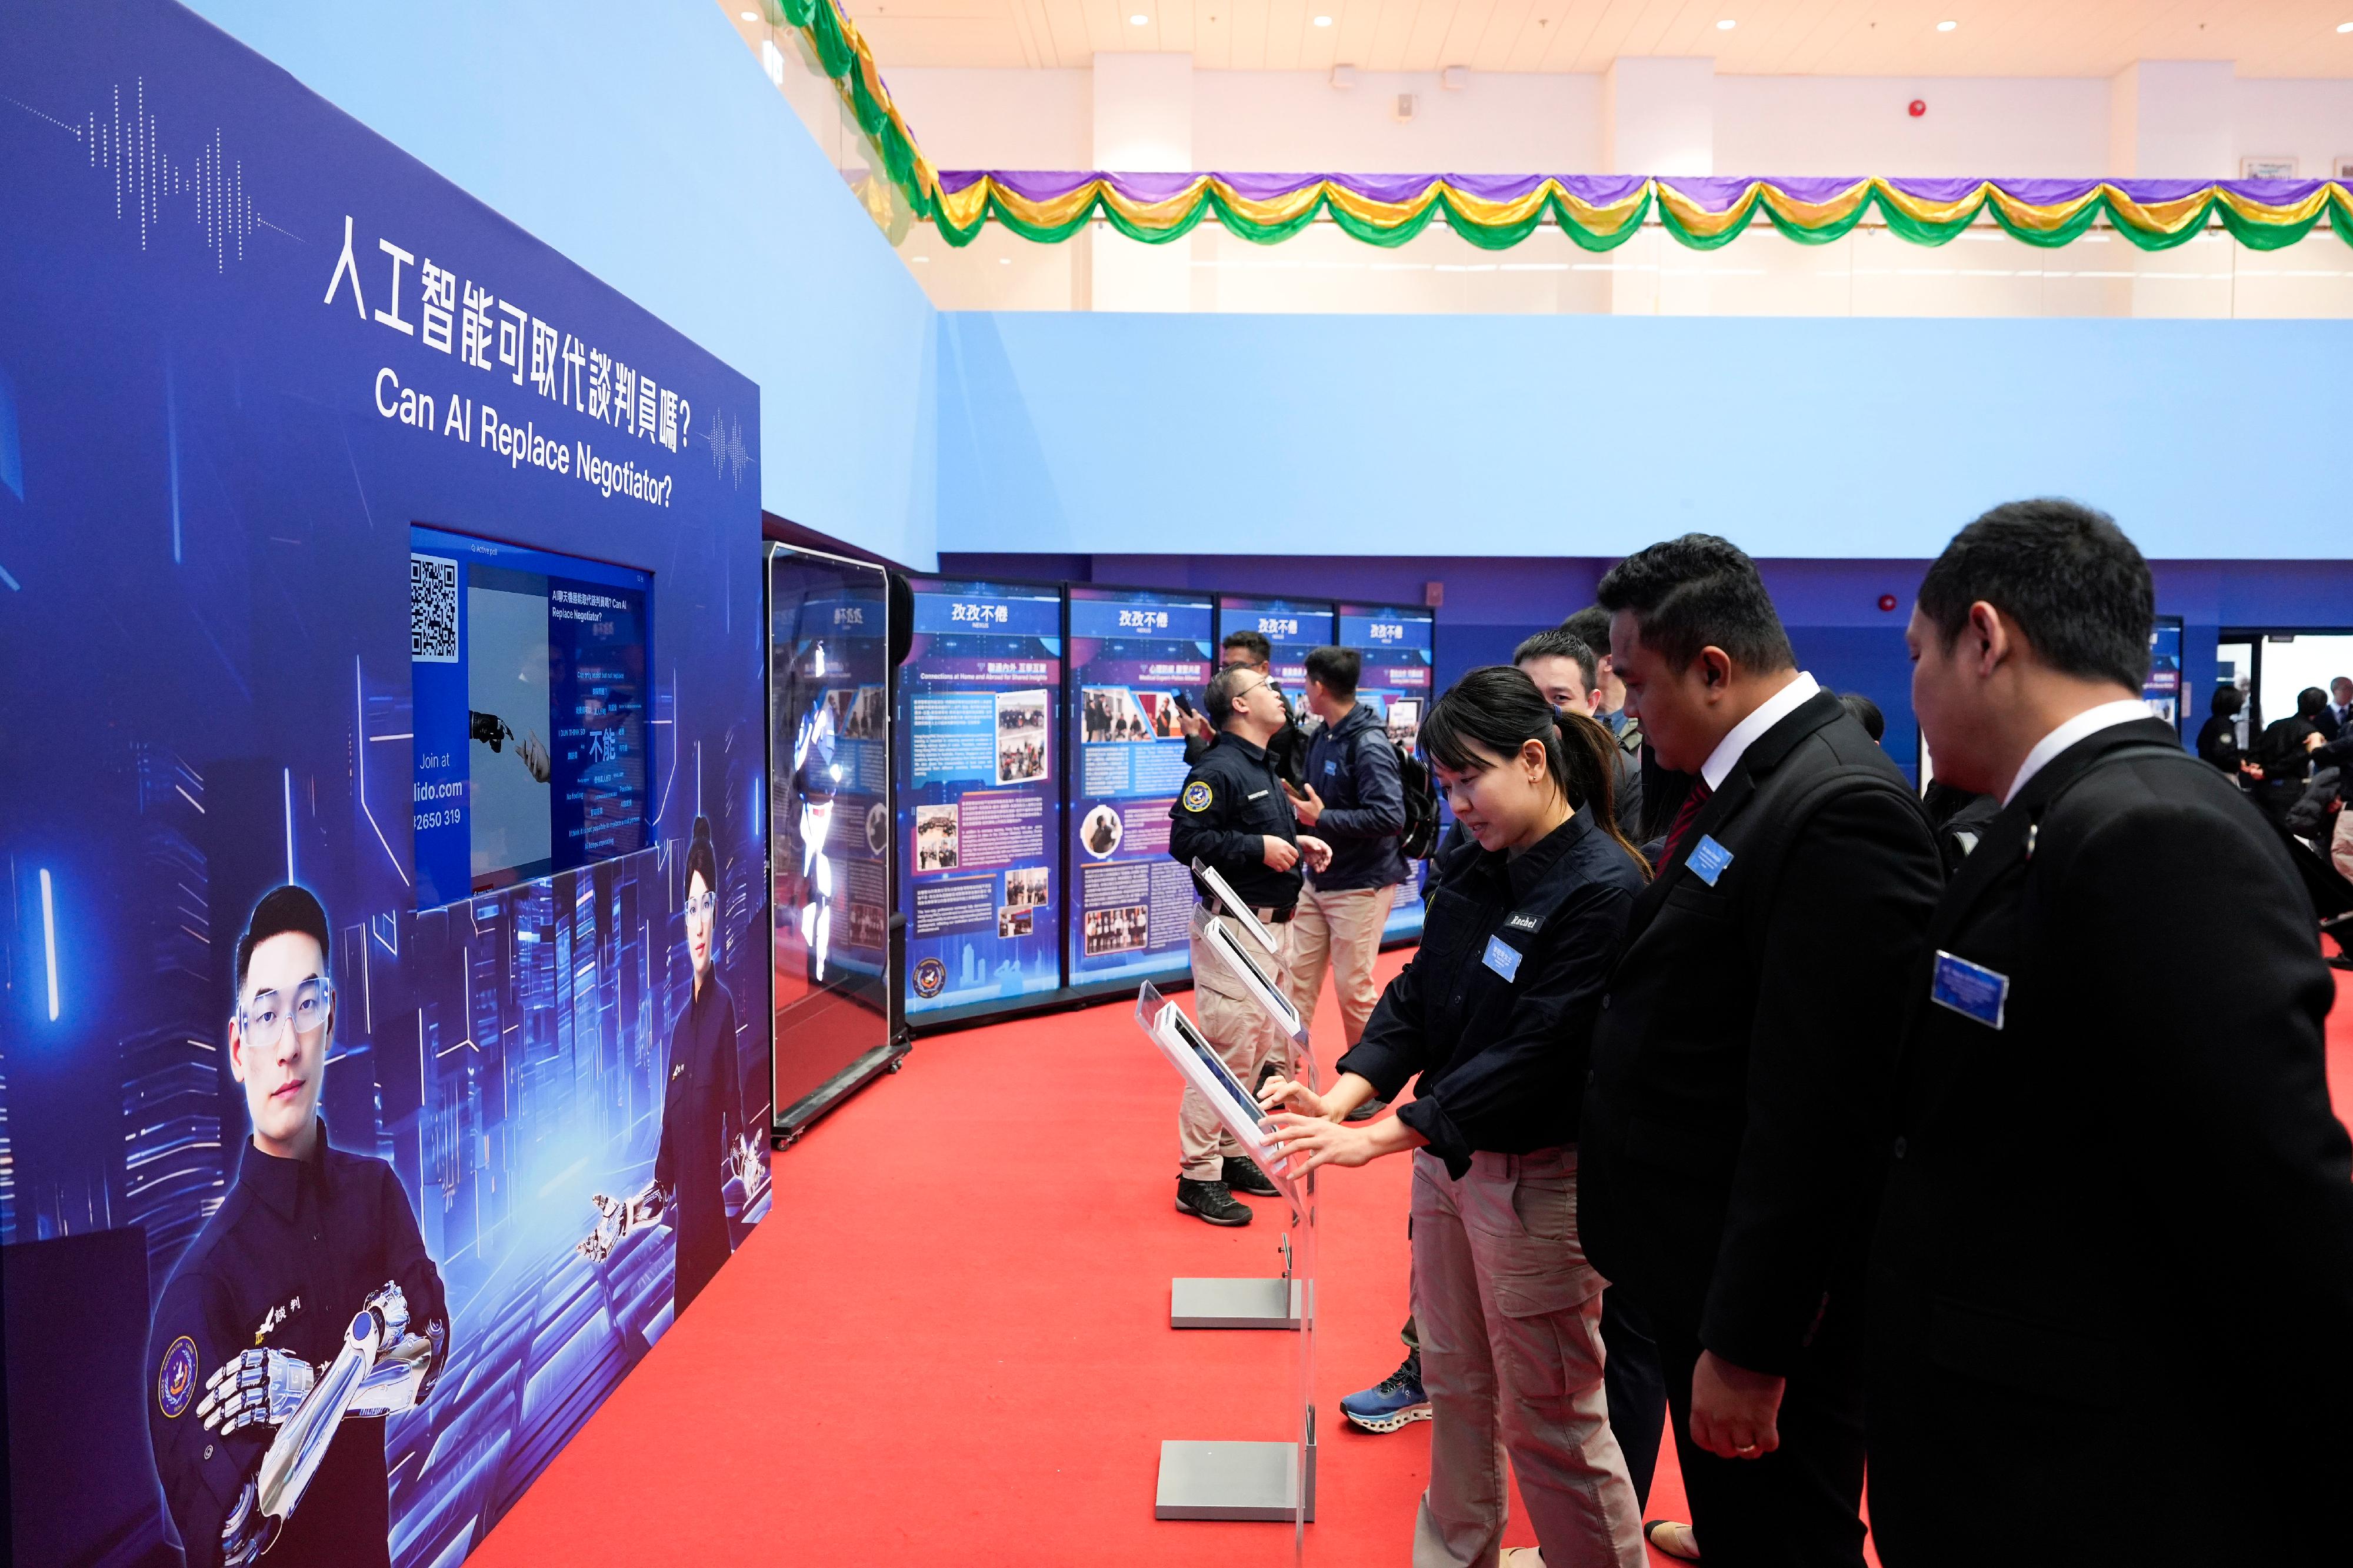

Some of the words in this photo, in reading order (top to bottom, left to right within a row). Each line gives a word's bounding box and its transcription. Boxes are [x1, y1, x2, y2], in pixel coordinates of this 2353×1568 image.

[324, 215, 691, 453] 人工智能可取代談判員嗎?
[375, 367, 435, 432] Can
[444, 393, 471, 443] AI
[481, 405, 569, 475] Replace
[576, 441, 672, 508] Negotiator?
[476, 545, 489, 554] Active
[612, 600, 622, 609] Can
[622, 600, 627, 610] AI
[552, 606, 573, 620] Replace
[574, 609, 602, 622] Negotiator?
[589, 728, 616, 763] 不能
[419, 753, 439, 769] Join
[441, 752, 450, 767] at
[572, 791, 584, 800] feeling
[444, 809, 461, 825] 319
[592, 823, 606, 833] possible
[598, 838, 614, 848] repeating
[1510, 916, 1537, 929] Rachel
